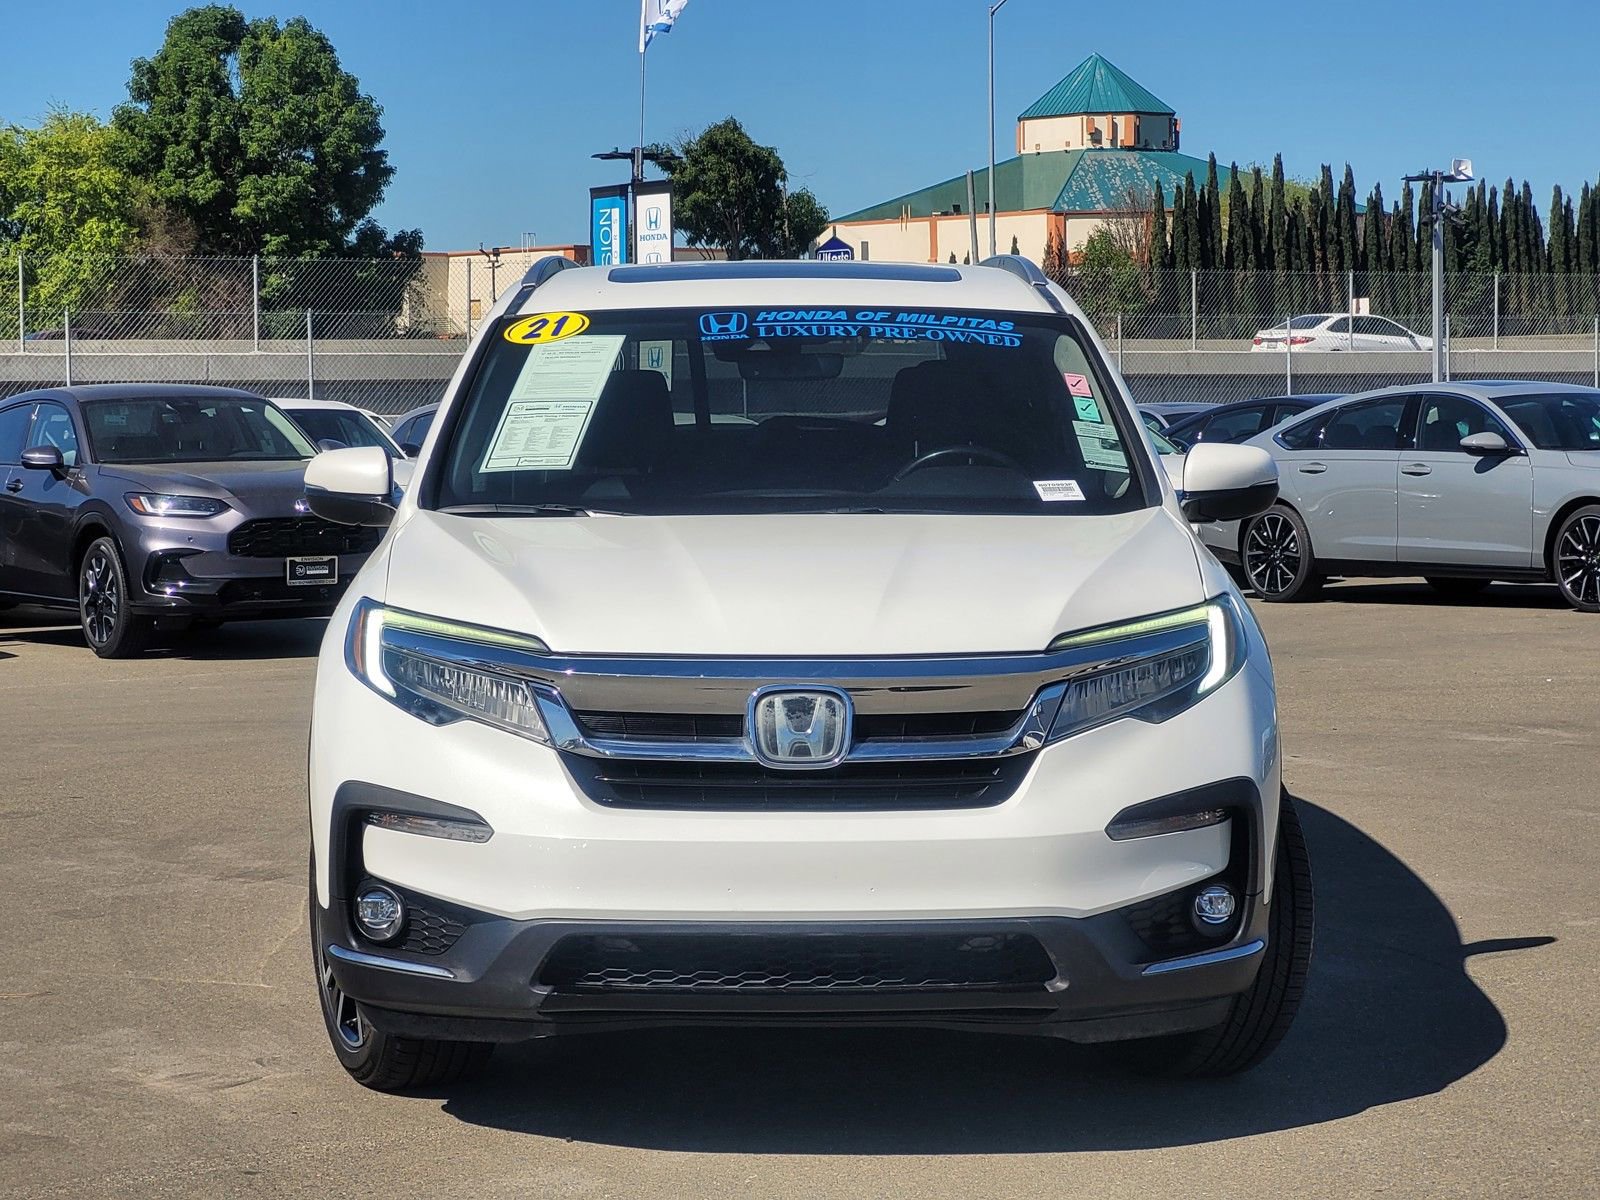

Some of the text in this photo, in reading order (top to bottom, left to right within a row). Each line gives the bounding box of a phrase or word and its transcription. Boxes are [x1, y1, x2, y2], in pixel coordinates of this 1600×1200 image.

[639, 233, 668, 242] HONDA
[521, 315, 570, 340] 21
[756, 311, 1015, 331] HONDA OF MILPITAS
[700, 333, 750, 341] HONDA
[757, 325, 1021, 347] LUXURY PRE-OWNED
